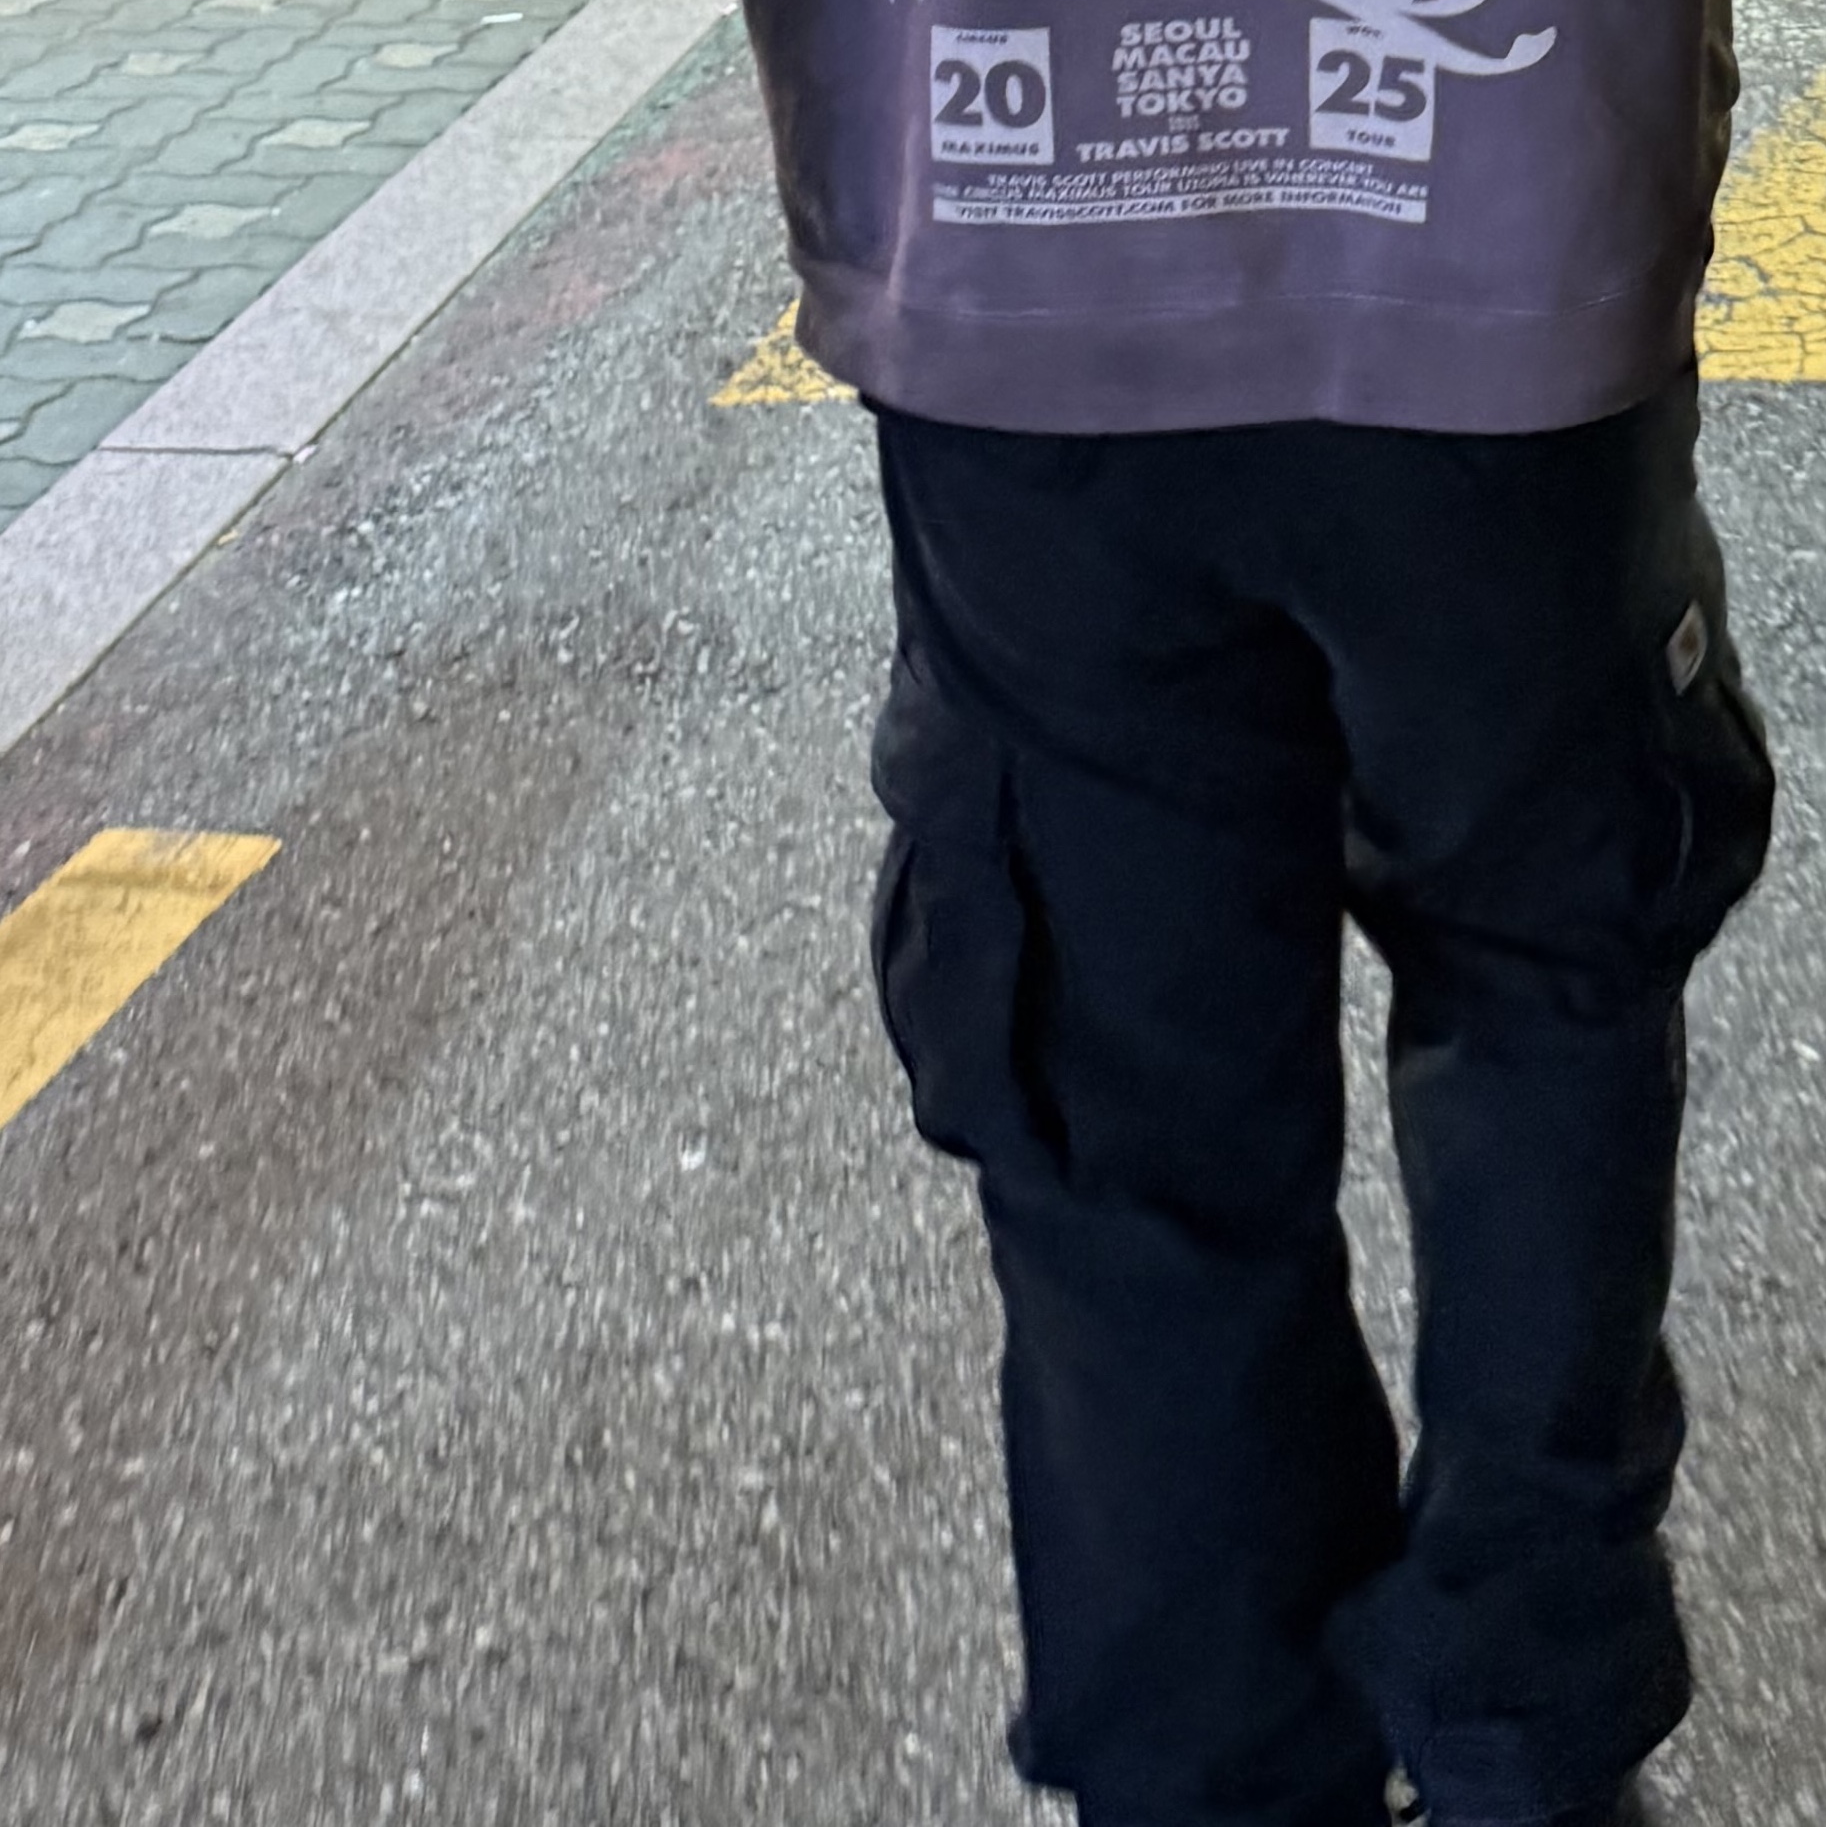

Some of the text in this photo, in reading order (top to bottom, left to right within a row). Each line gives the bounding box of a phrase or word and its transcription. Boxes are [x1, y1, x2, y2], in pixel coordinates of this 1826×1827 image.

[1120, 17, 1242, 47] SEOUL
[1111, 39, 1250, 72] MACAU
[934, 58, 1047, 129] 20
[1117, 64, 1248, 95] SANYA
[1315, 49, 1427, 122] 25
[1116, 85, 1248, 118] TOKYO
[941, 140, 1040, 157] MAXIMUS
[1076, 127, 1291, 163] TRAVIS SCOTT
[1346, 128, 1397, 148] TOUR
[1181, 194, 1217, 211] FOR
[1222, 190, 1275, 206] MORE
[1280, 189, 1403, 216] INFORMATION
